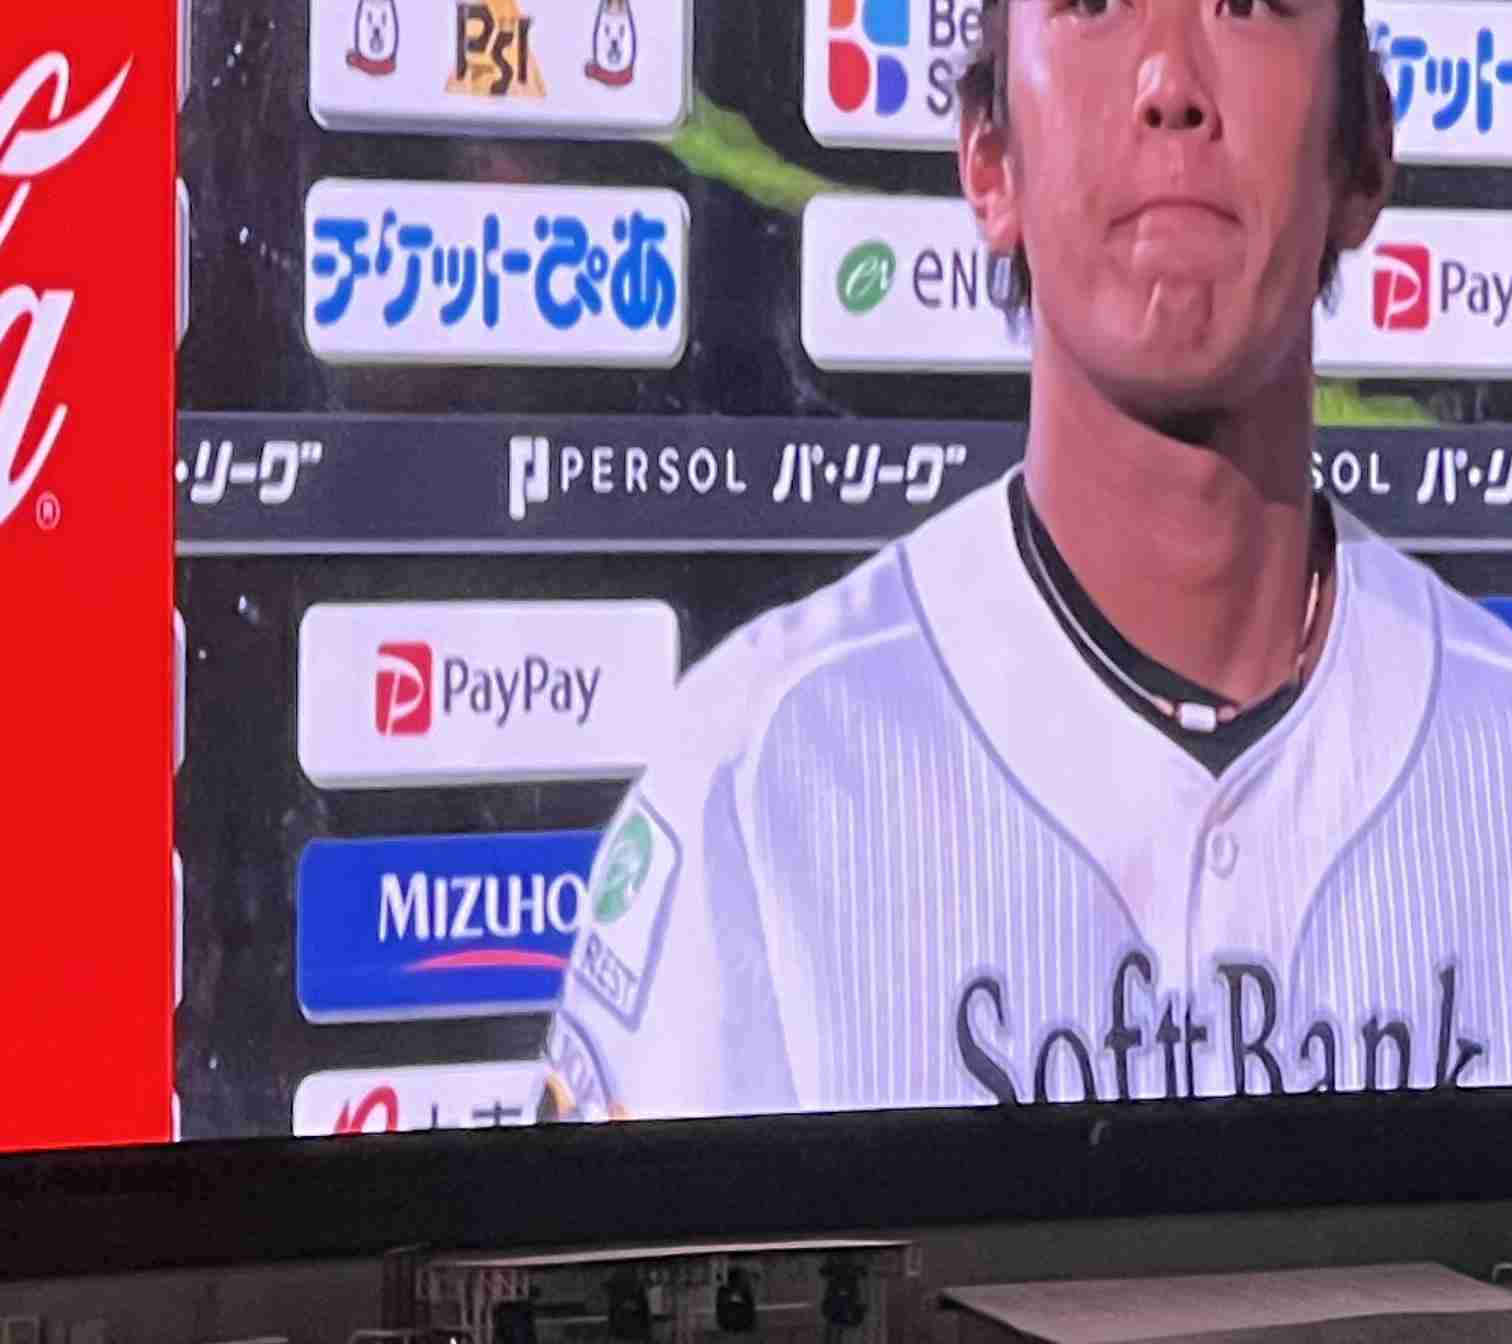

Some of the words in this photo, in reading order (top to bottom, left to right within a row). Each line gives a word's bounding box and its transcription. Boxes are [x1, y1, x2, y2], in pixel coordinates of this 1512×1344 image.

[561, 446, 747, 494] PERSOL
[443, 656, 600, 727] PayPay
[379, 872, 586, 944] MIZUHO
[956, 951, 1488, 1105] SoftBank
